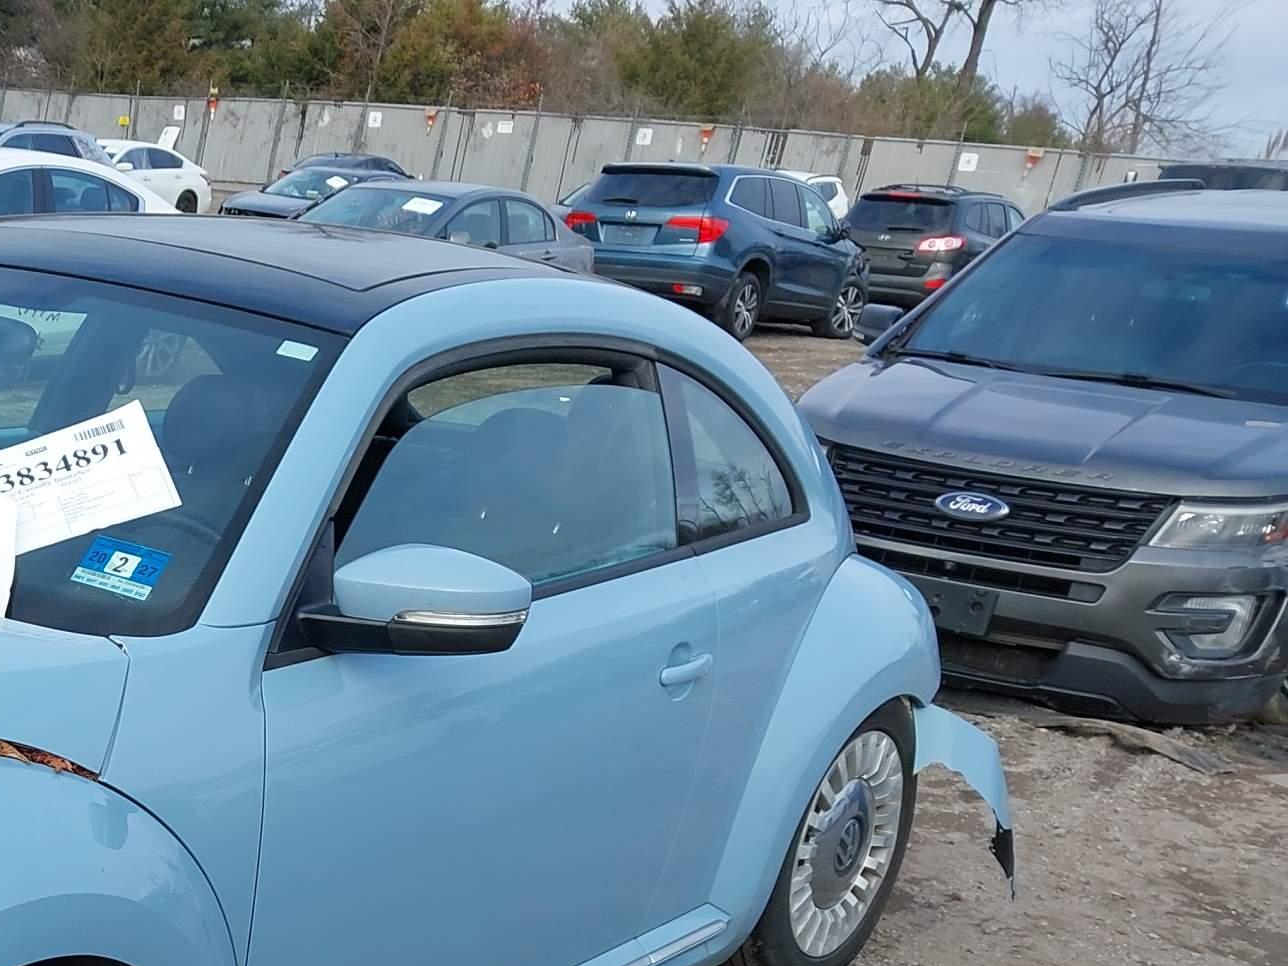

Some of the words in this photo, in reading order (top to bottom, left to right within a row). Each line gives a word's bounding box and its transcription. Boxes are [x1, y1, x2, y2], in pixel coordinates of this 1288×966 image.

[949, 495, 992, 514] Ford
[88, 551, 107, 563] 20
[112, 556, 129, 573] 2
[137, 565, 158, 577] 27
